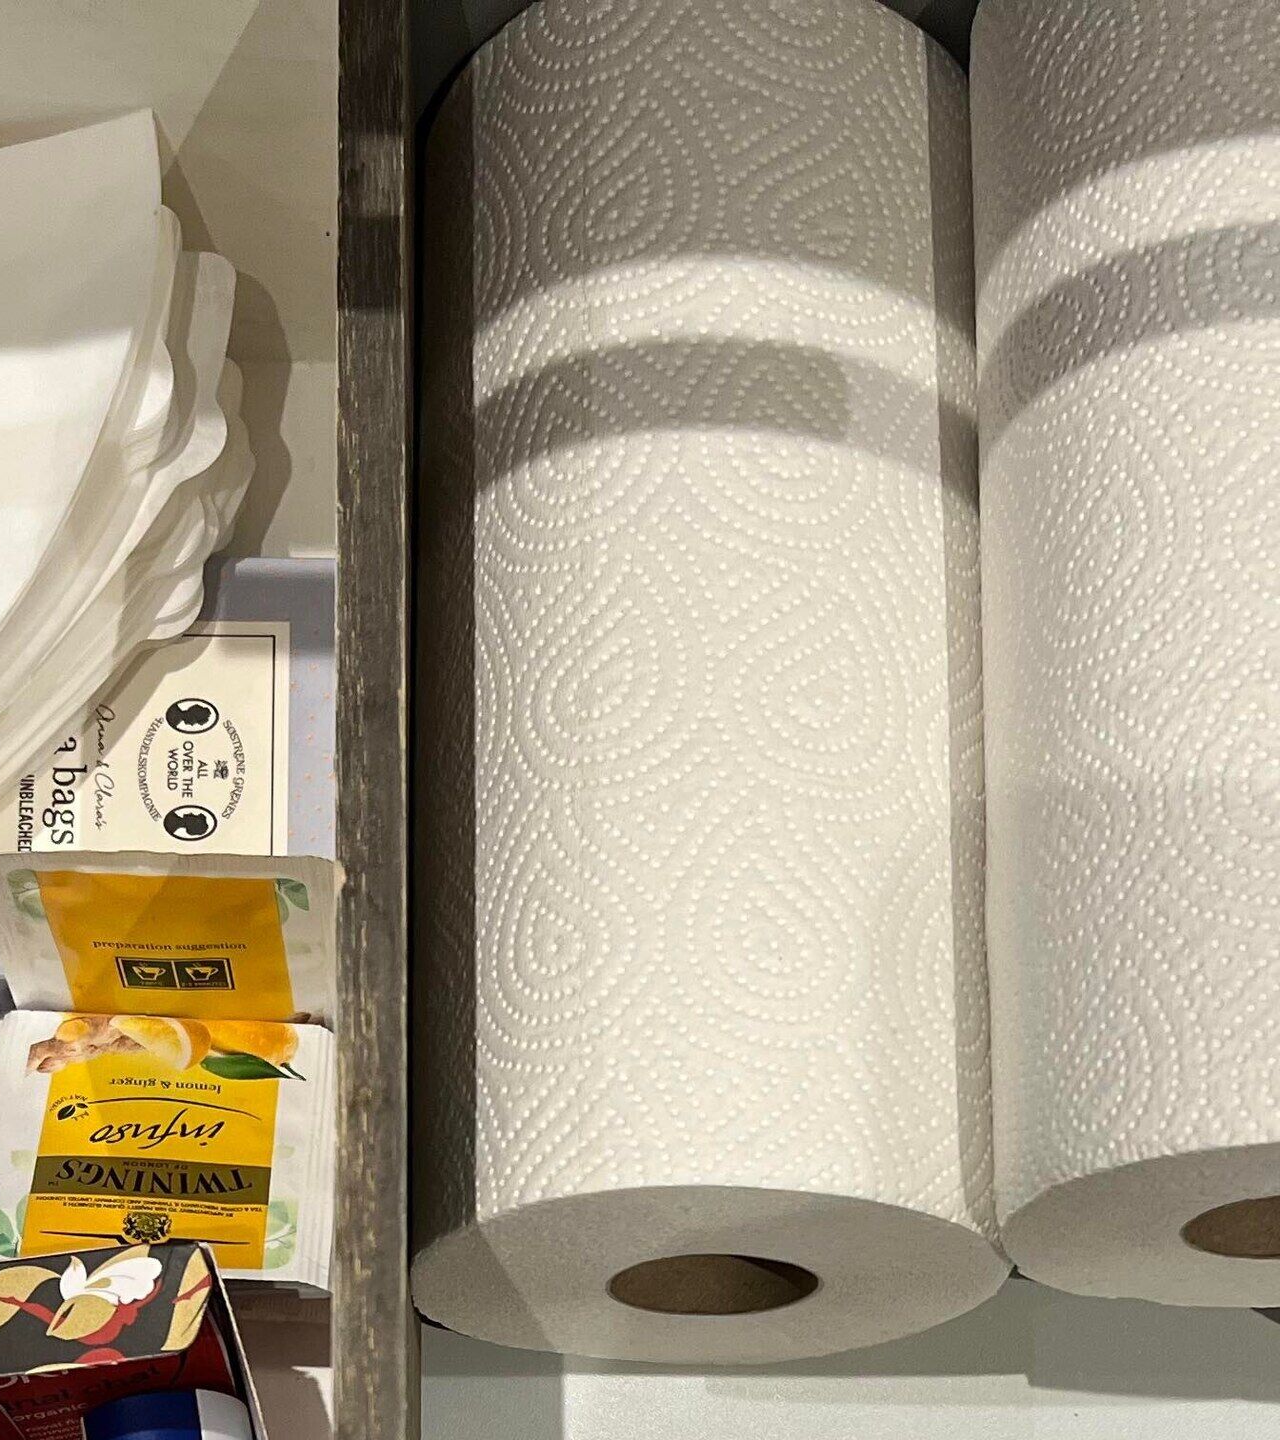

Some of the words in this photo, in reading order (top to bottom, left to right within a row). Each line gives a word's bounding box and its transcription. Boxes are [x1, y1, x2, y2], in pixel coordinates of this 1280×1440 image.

[182, 741, 193, 772] OVER
[222, 719, 246, 775] SØSTRENE
[137, 717, 164, 822] HANDELSKOMPAGNIE
[167, 748, 178, 790] WORLD
[197, 759, 208, 778] ALL
[182, 777, 193, 798] THE
[220, 777, 245, 820] GRENES
[42, 767, 88, 845] bags
[92, 940, 172, 951] preparation
[175, 942, 248, 952] suggestion
[109, 1077, 157, 1090] ginger
[160, 1082, 173, 1092] &
[175, 1081, 222, 1095] lemon
[89, 1108, 225, 1150] infuso
[55, 1158, 253, 1196] TWININGS
[122, 1160, 170, 1171] LONDON
